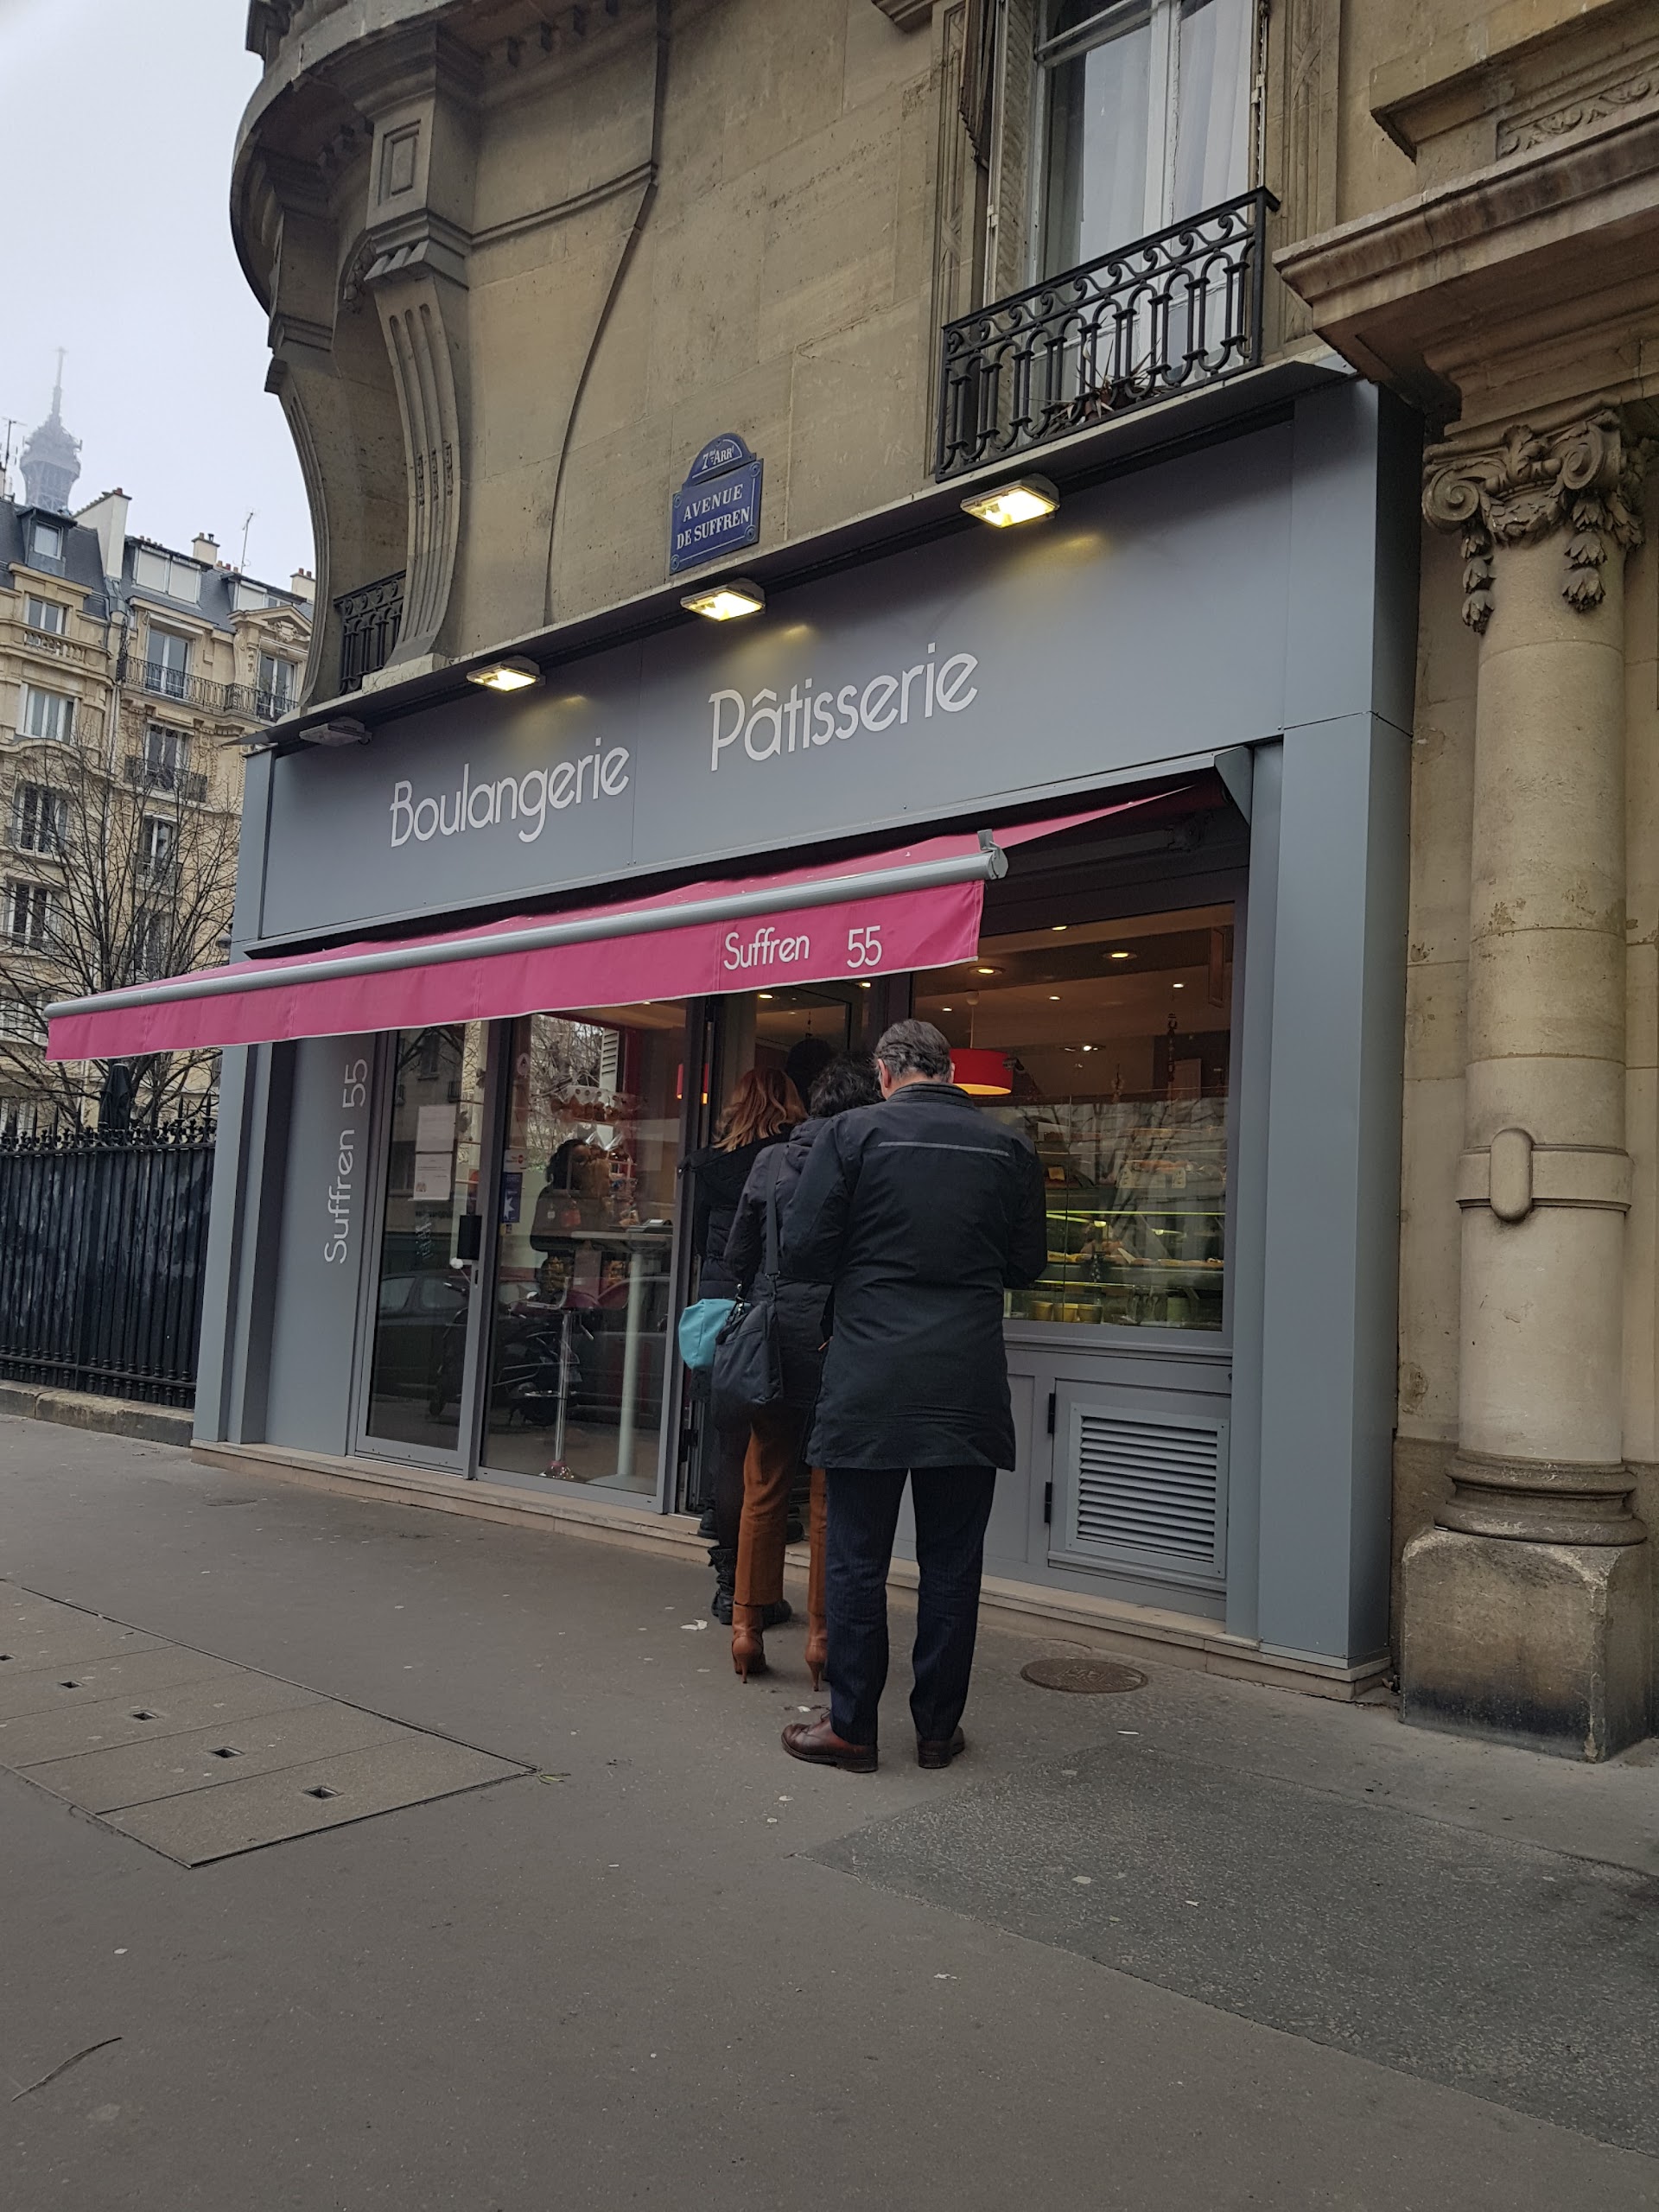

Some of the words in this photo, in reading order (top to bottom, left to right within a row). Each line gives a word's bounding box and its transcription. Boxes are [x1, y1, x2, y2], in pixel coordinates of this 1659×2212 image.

[683, 484, 743, 522] AVENUE
[677, 529, 692, 550] DE
[694, 506, 750, 542] SUFFREN
[389, 736, 630, 848] Boulangerie
[709, 642, 978, 772] Pâtisserie
[723, 926, 810, 970] Suffren
[846, 925, 883, 969] 55
[324, 1128, 355, 1264] Suffren
[342, 1058, 368, 1109] 55
